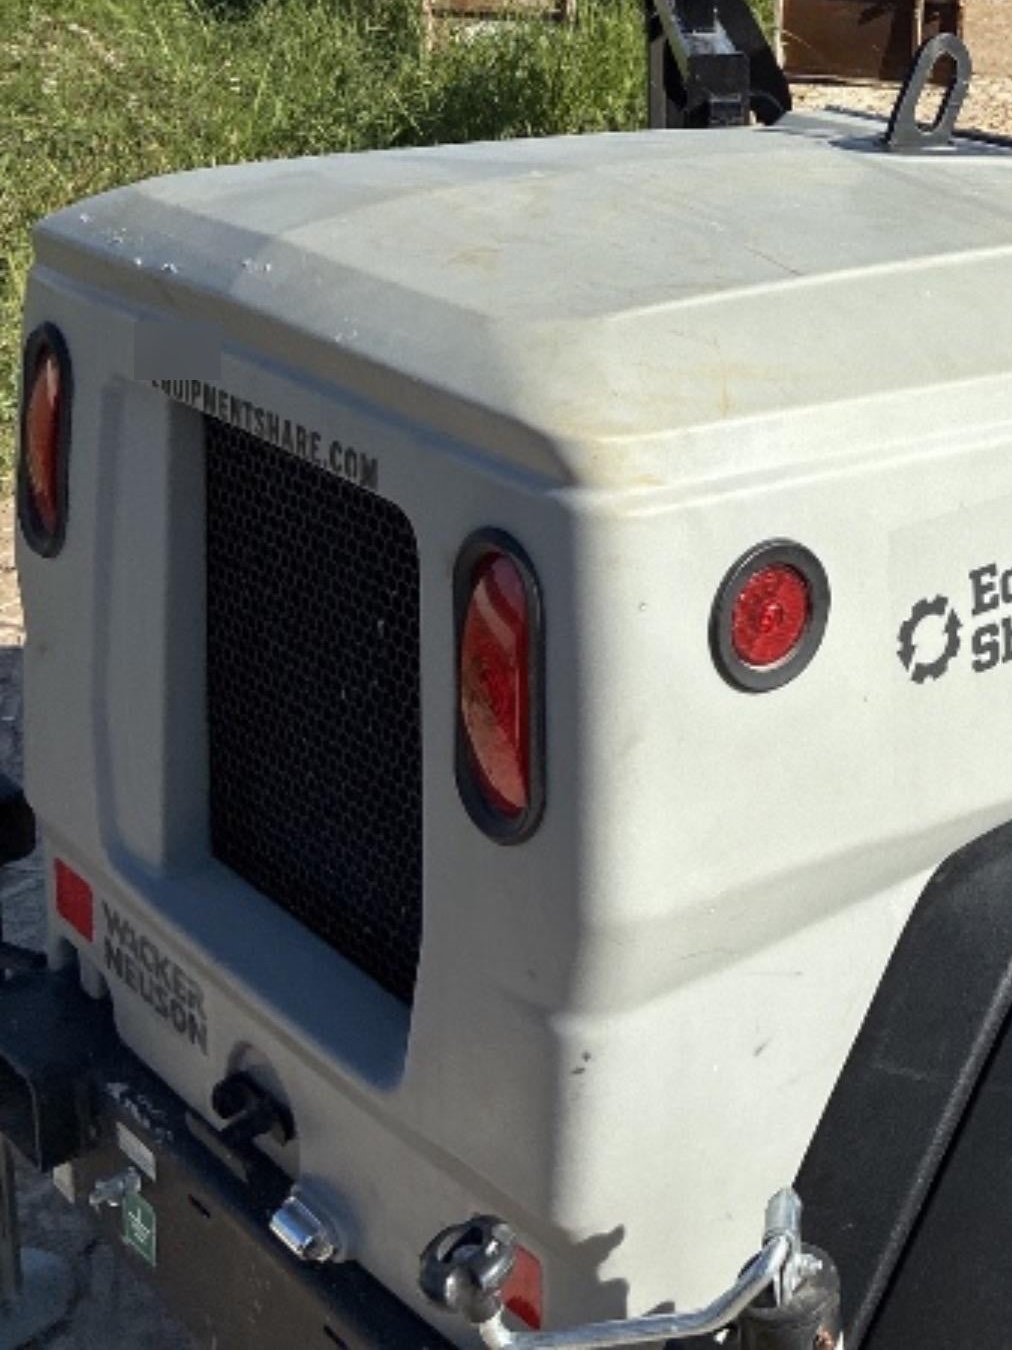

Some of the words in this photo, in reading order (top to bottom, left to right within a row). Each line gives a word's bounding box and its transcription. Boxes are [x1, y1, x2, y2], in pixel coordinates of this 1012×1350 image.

[151, 380, 379, 490] QUIPMENTSHARE.COM
[102, 900, 208, 1021] WACKER
[104, 935, 209, 1057] NEUSON
